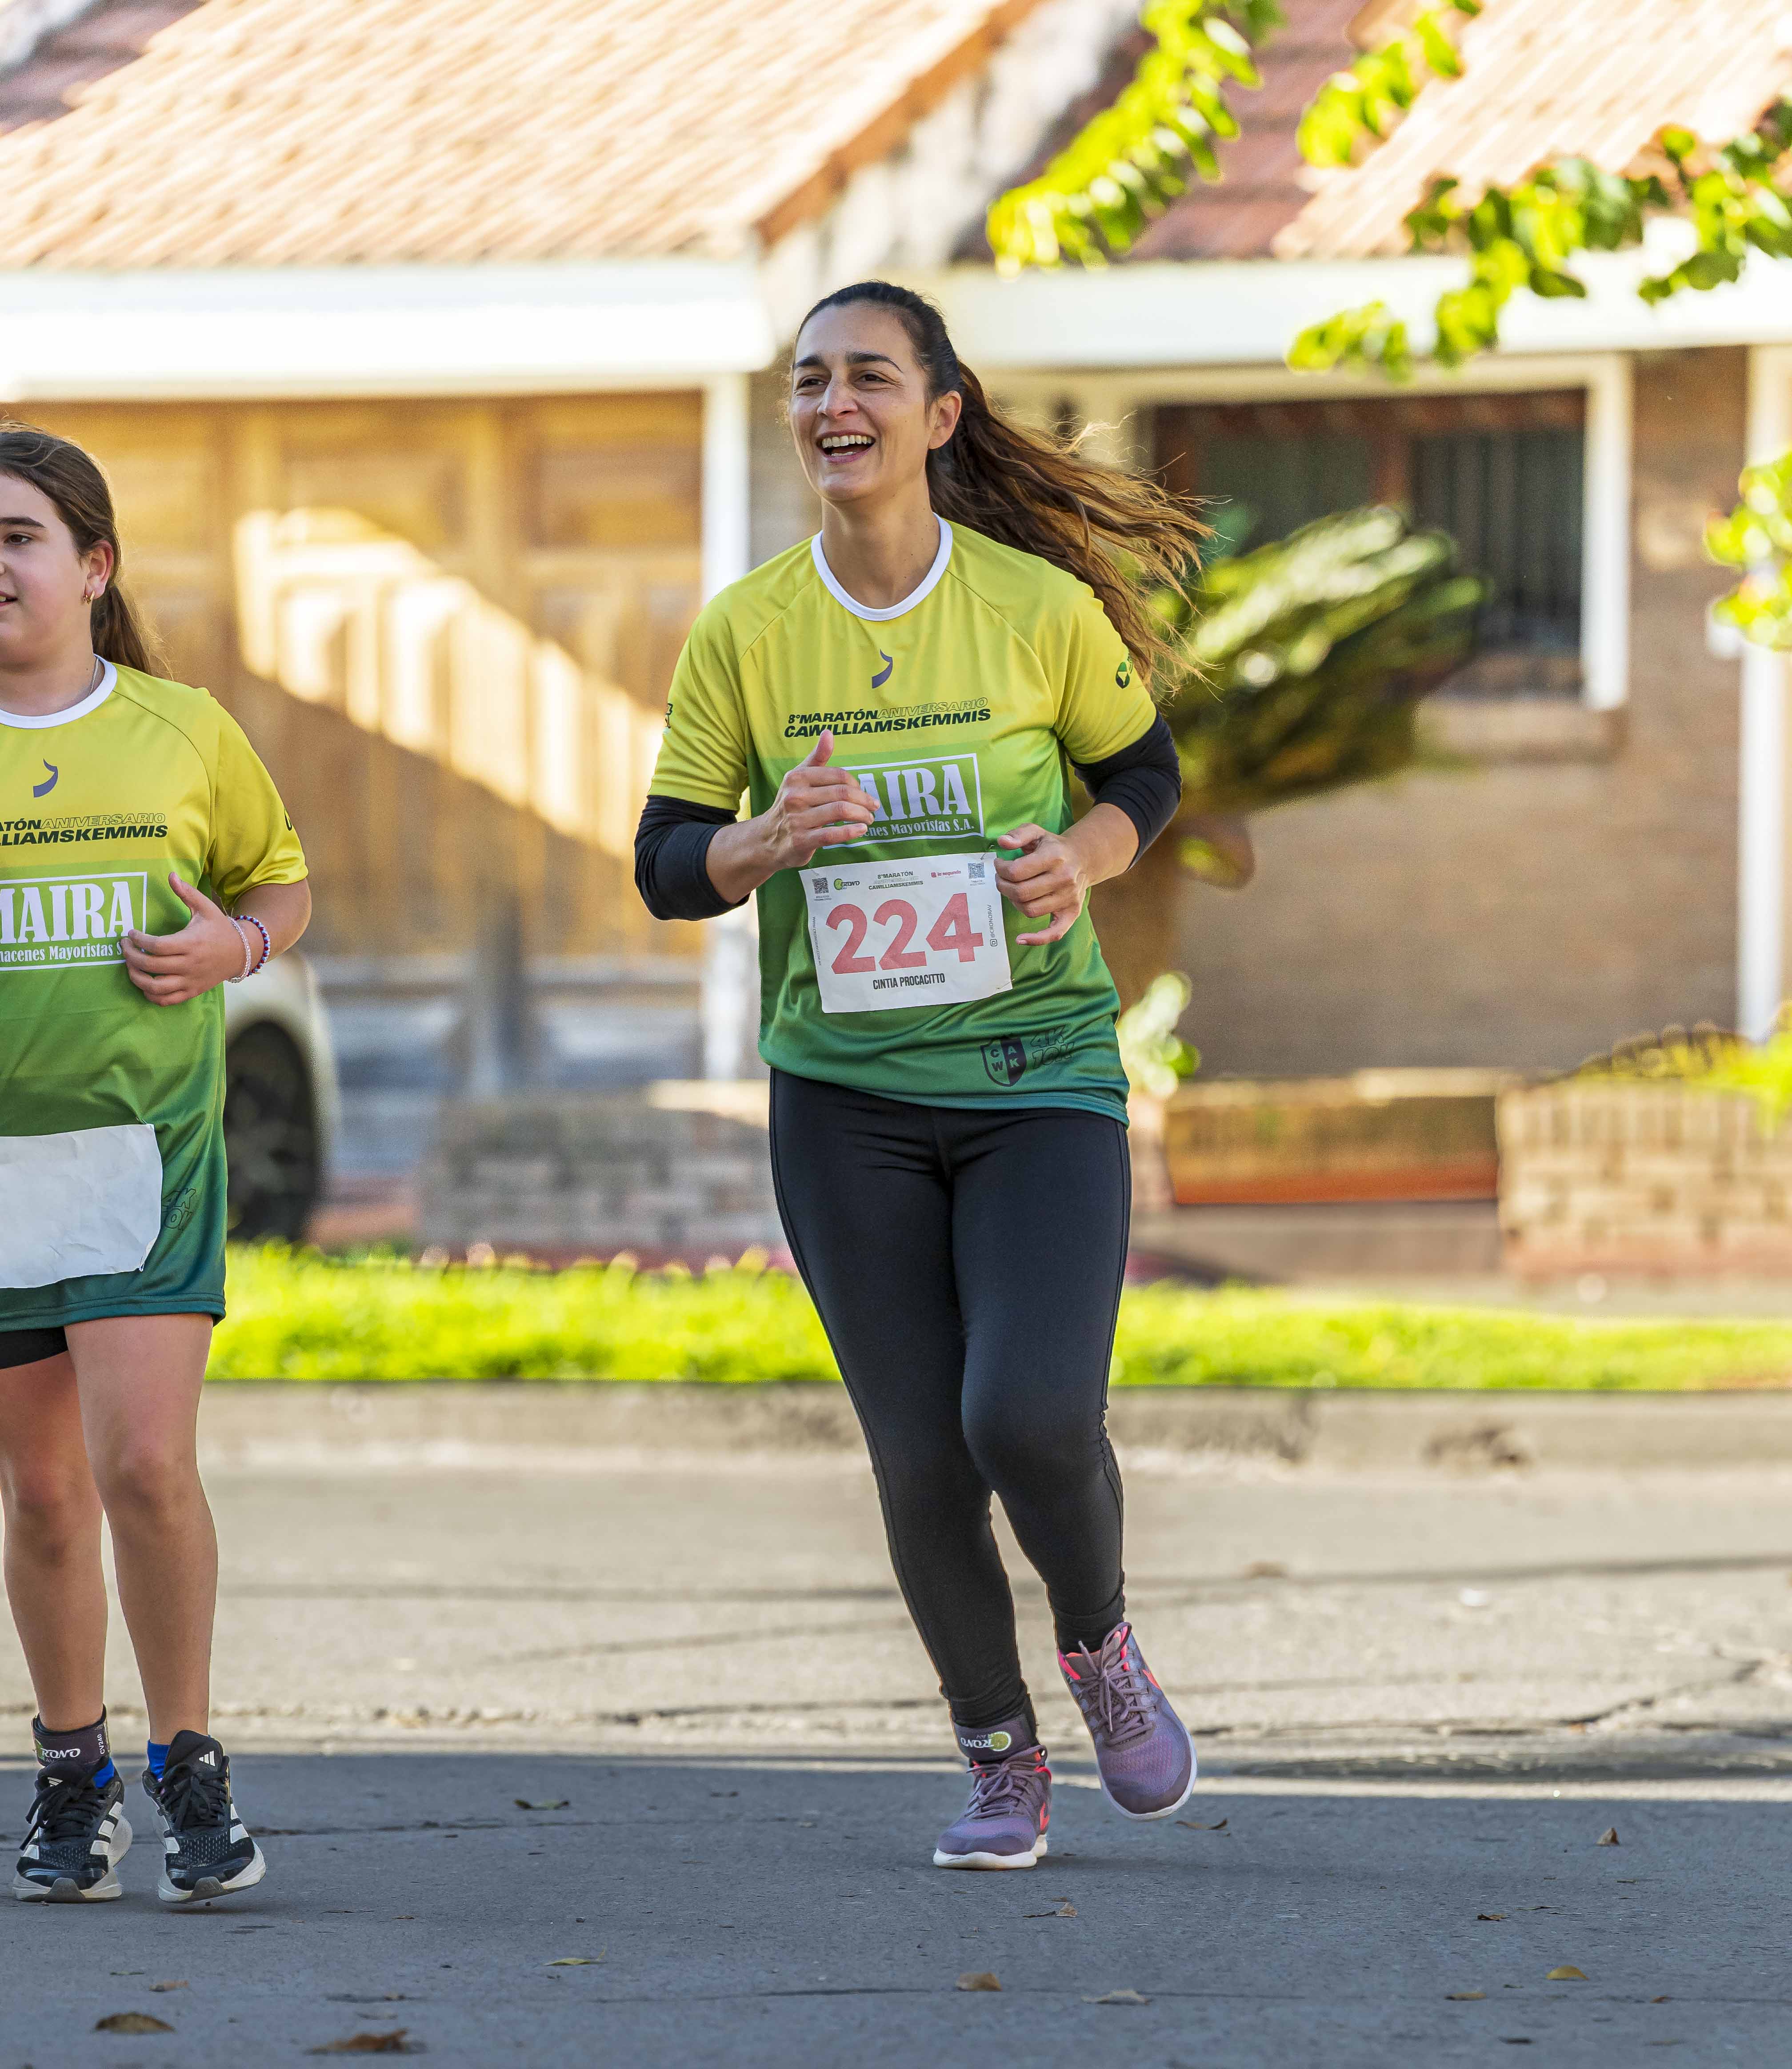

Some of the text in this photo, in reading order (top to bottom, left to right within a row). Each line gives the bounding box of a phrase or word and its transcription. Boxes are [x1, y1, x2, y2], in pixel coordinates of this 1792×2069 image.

[876, 697, 988, 719] ANIVERSARIO
[858, 764, 972, 822] AIRA
[40, 813, 166, 830] ANIVERSARIO
[890, 820, 950, 835] Mayoristas
[953, 819, 975, 832] S.A.
[0, 825, 168, 846] LIAMSKEMMIS
[868, 880, 924, 890] CAWILLIAMSKEMMIS
[826, 892, 984, 975] 224
[0, 947, 45, 963] acenes
[49, 943, 114, 960] Mayoristas
[872, 973, 945, 990] CINTIA PROCACITTO
[96, 1733, 105, 1755] CV240
